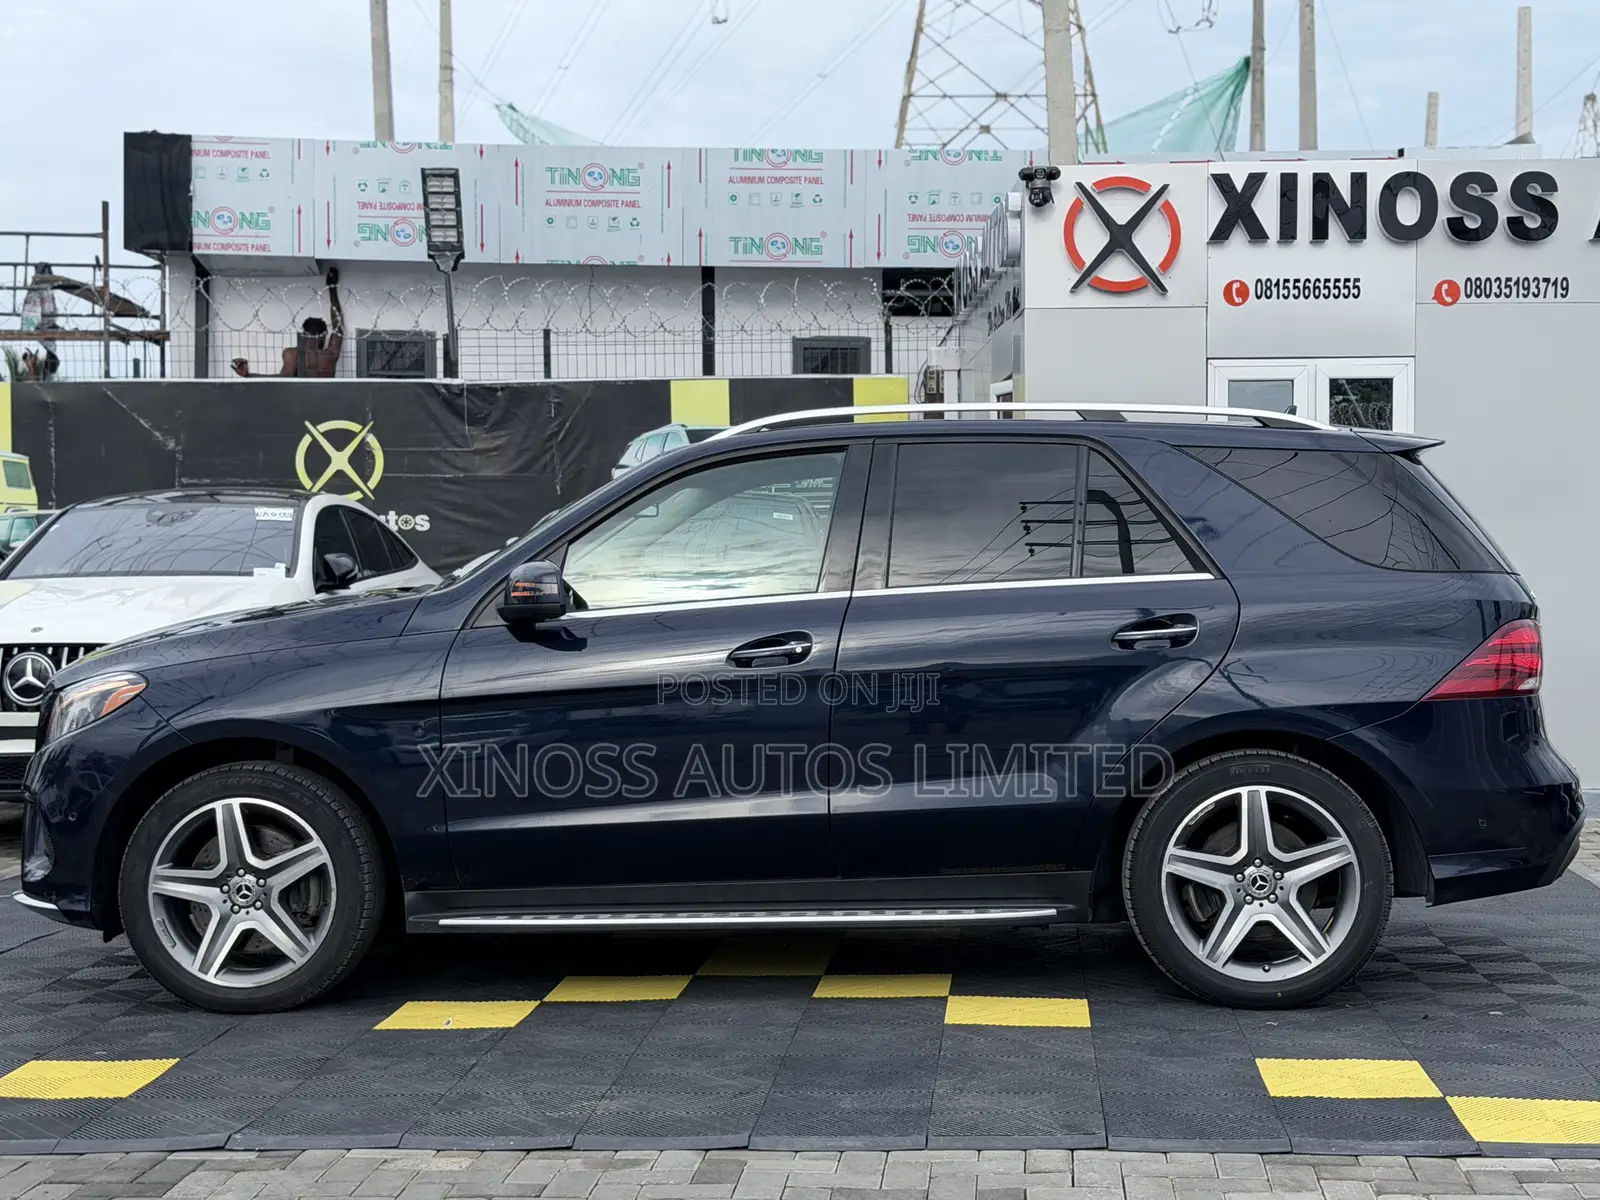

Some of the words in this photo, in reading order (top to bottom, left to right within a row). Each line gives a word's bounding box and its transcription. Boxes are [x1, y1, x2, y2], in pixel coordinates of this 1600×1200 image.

[250, 150, 271, 159] PANEL
[727, 175, 765, 185] ALUMINIUM
[766, 176, 802, 185] COMPOSITE
[804, 176, 825, 185] PANEL
[583, 199, 619, 208] COMPOSITE
[621, 200, 642, 209] PANEL
[1207, 170, 1560, 243] XINOSS
[250, 244, 272, 253] PANEL
[1254, 277, 1361, 300] 08155665555
[1464, 276, 1570, 299] 08035193719
[380, 510, 431, 531] tos
